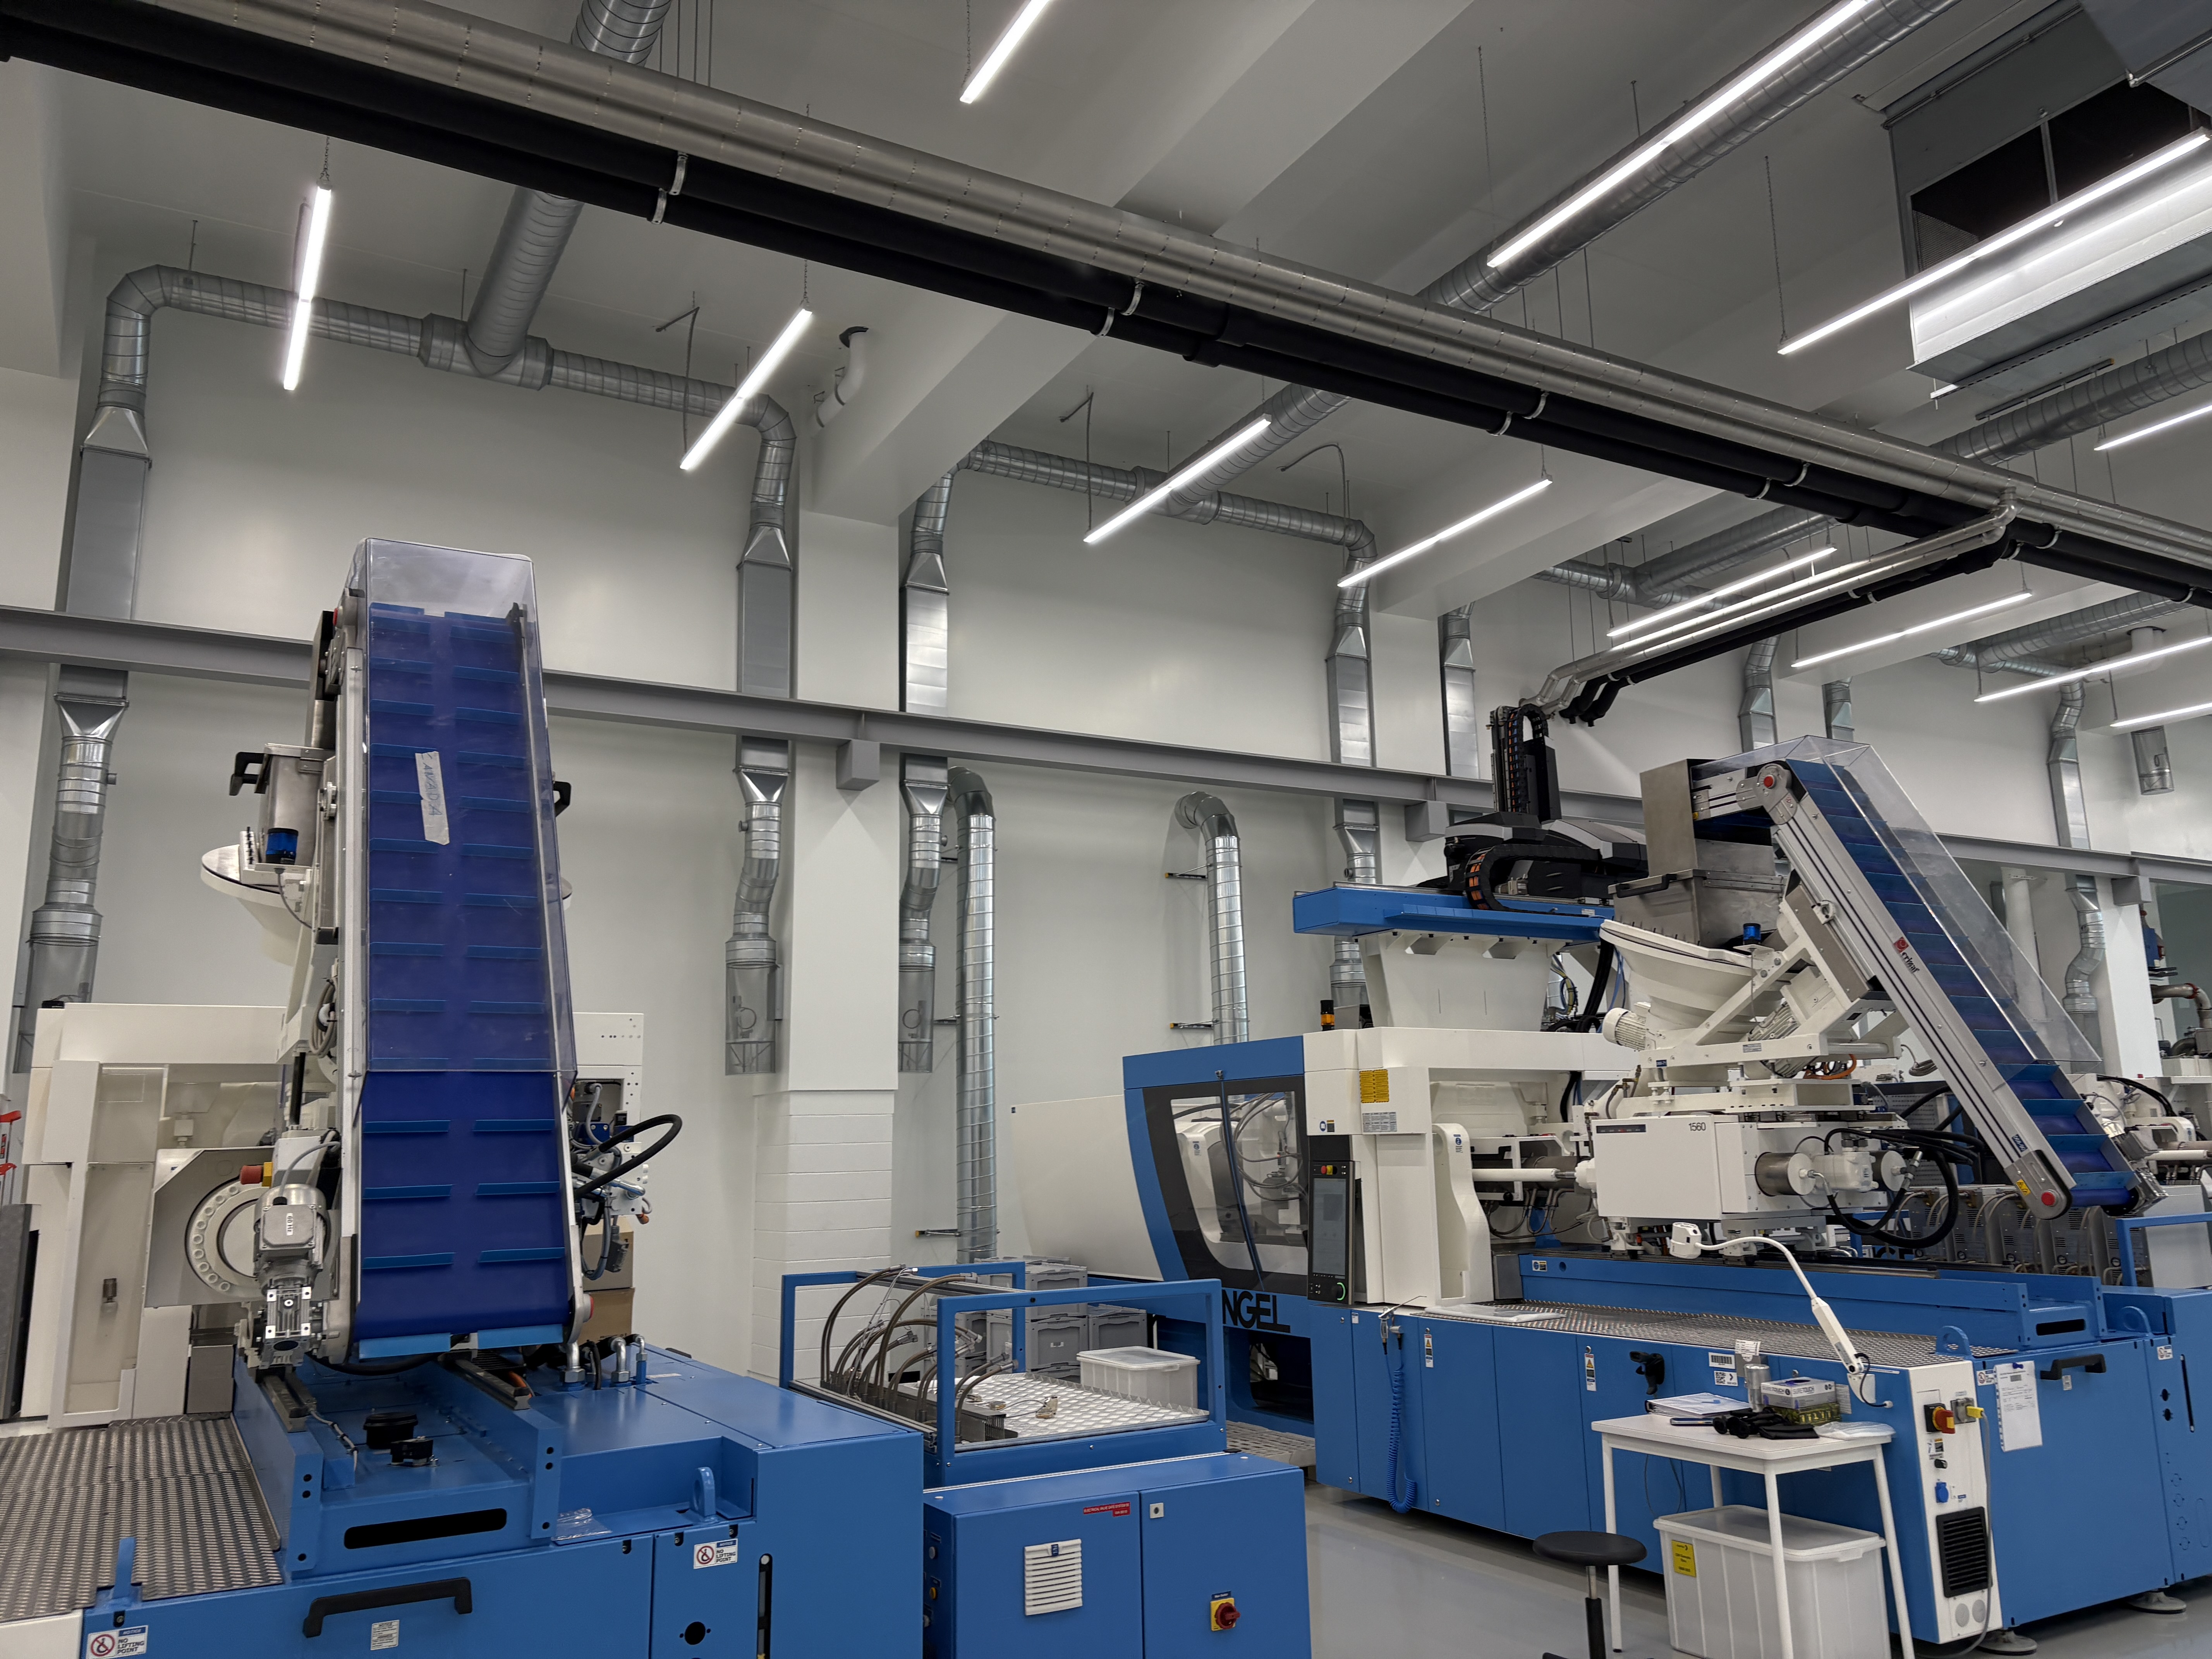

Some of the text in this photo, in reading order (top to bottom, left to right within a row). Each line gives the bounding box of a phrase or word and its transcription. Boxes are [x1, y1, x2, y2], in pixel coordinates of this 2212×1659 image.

[1688, 1122, 1706, 1131] 1560
[1222, 1289, 1291, 1333] NGEL
[117, 1641, 145, 1649] LIFTING
